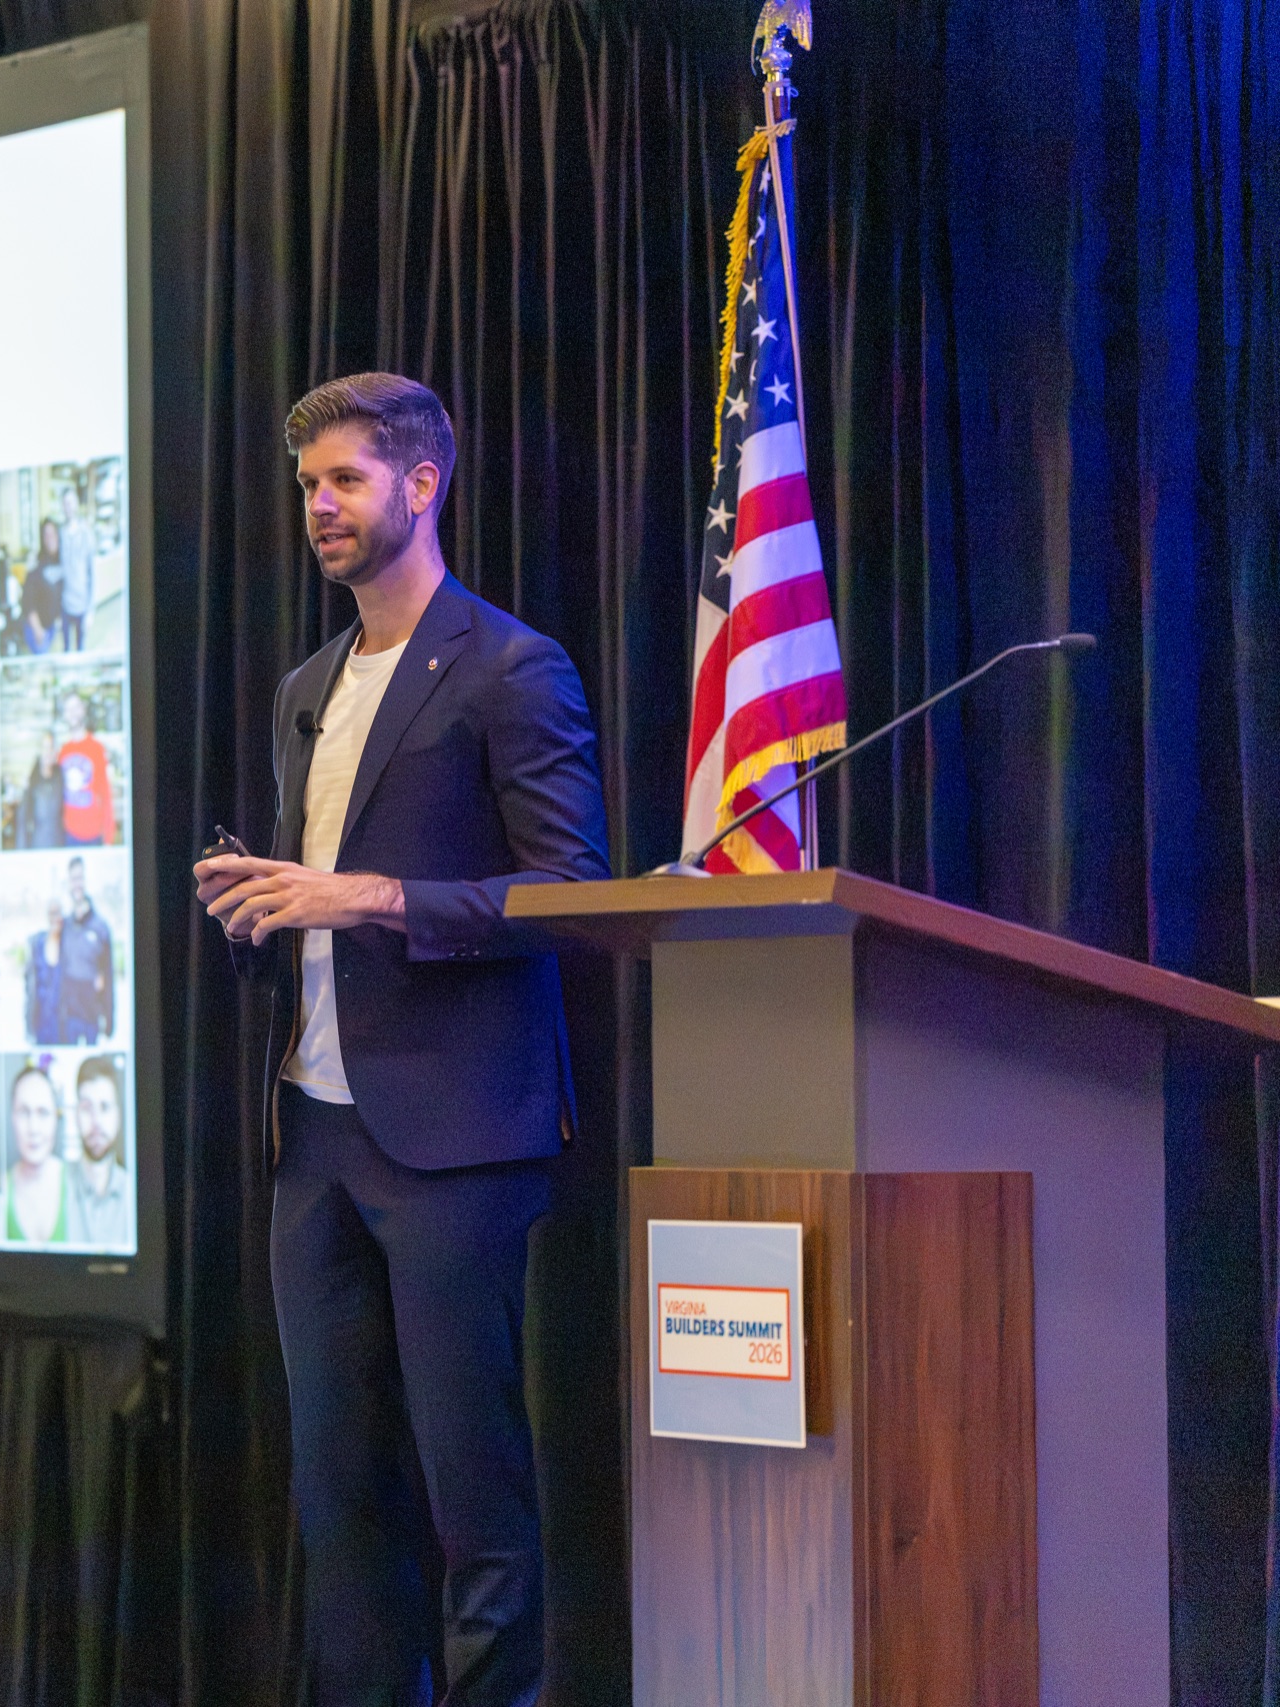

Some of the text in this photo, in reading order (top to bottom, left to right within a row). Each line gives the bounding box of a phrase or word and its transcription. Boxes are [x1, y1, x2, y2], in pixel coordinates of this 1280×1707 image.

[665, 1300, 706, 1315] VIRGINIA
[666, 1317, 782, 1339] BUILDERS SUMMIT
[748, 1342, 782, 1364] 2026
